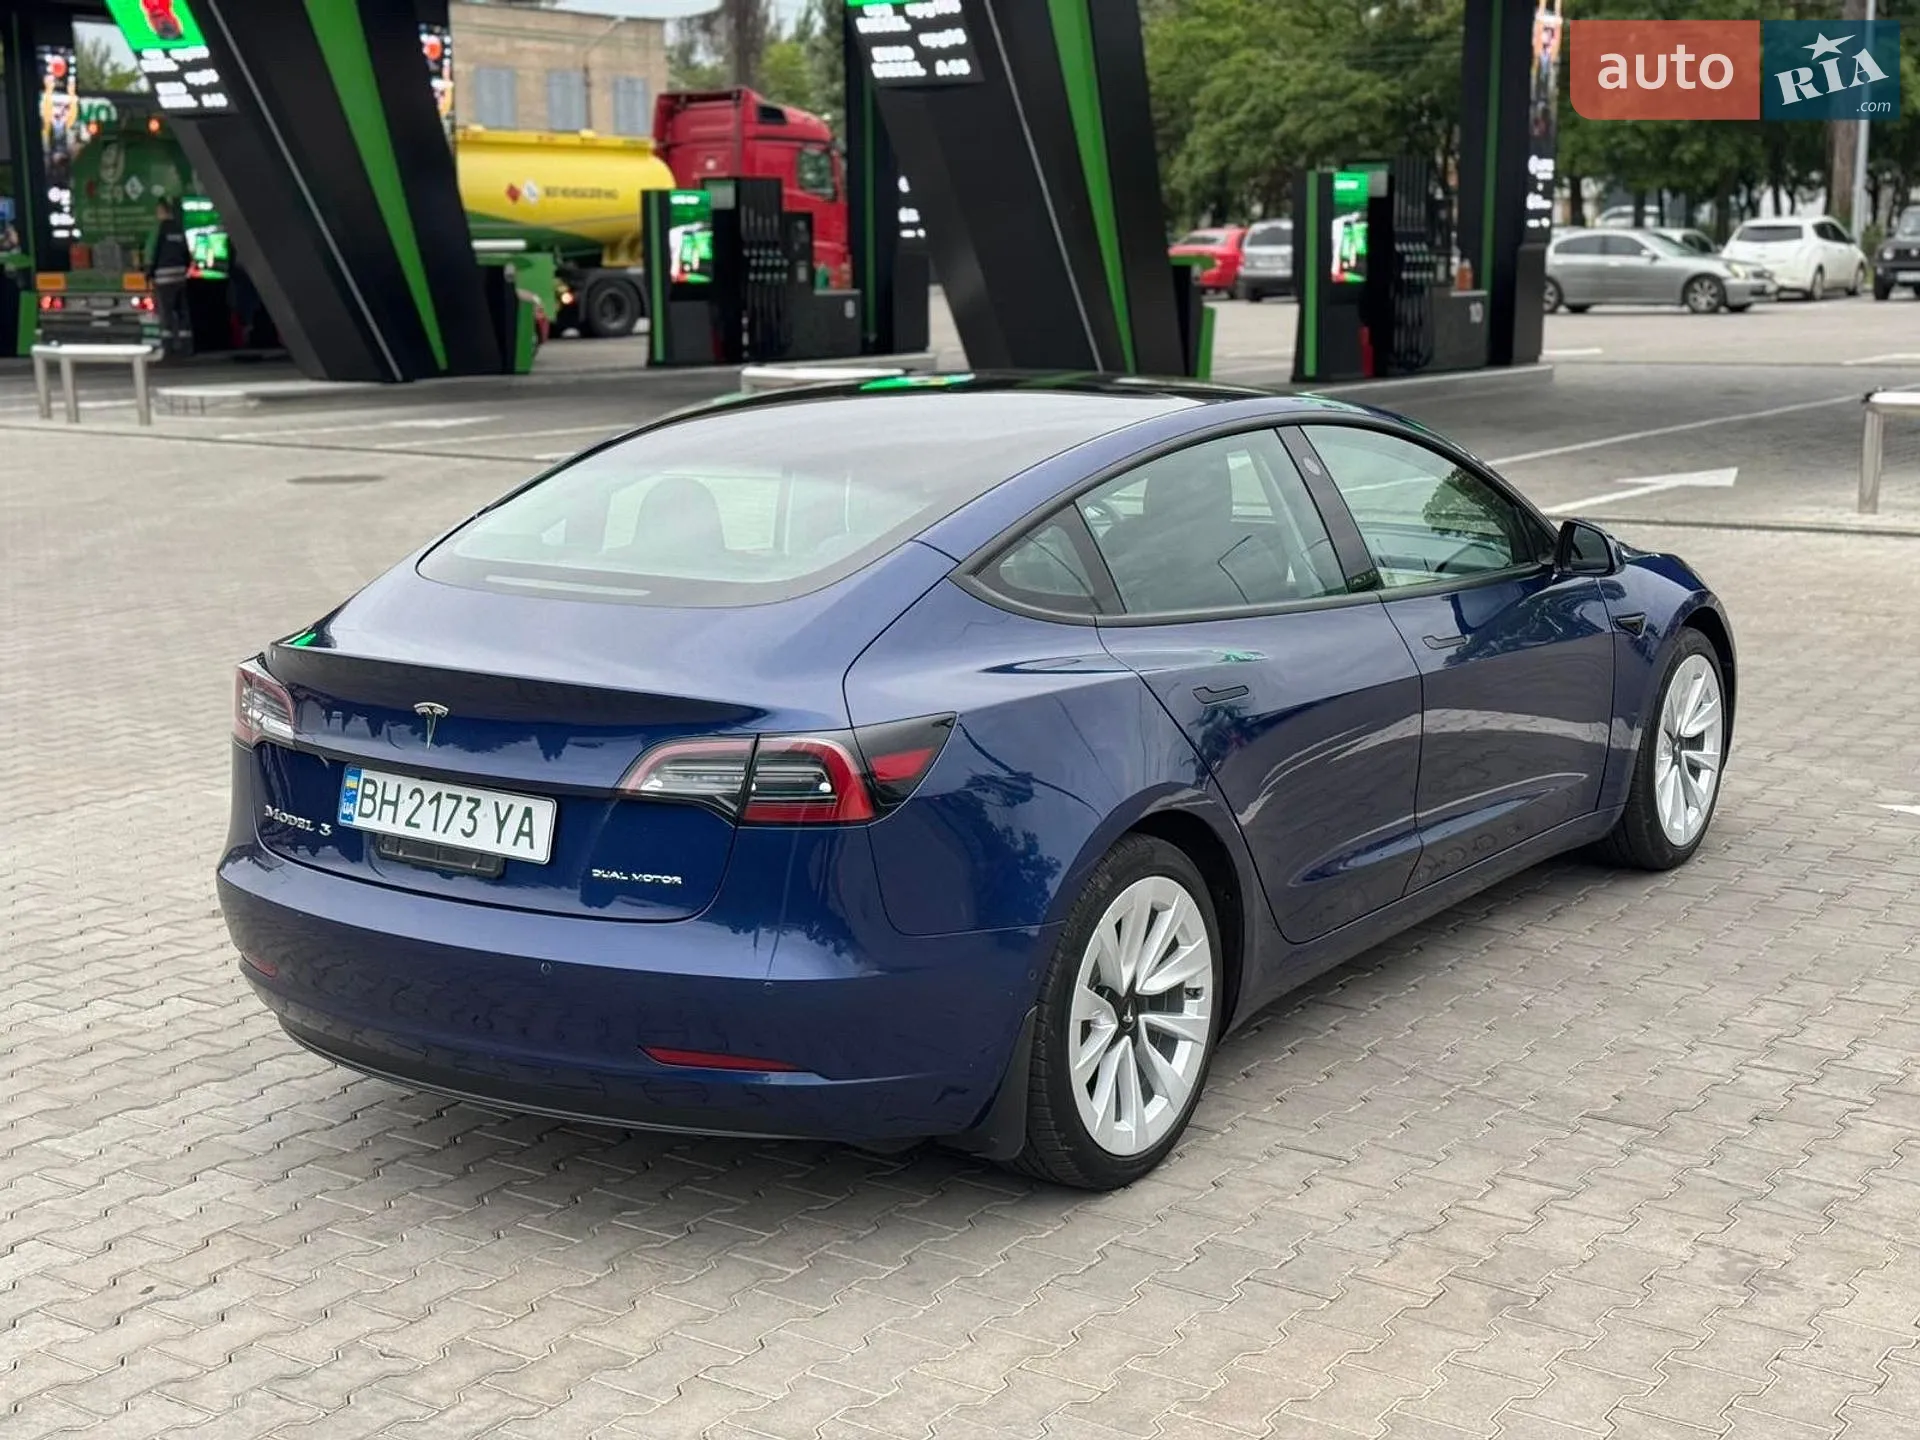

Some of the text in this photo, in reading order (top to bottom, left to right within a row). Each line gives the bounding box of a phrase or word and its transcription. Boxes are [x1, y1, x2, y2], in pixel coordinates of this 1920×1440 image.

[264, 805, 332, 836] MODEL 3
[357, 778, 535, 849] BH 2173 YA
[591, 868, 682, 885] DUAL MOTOR
